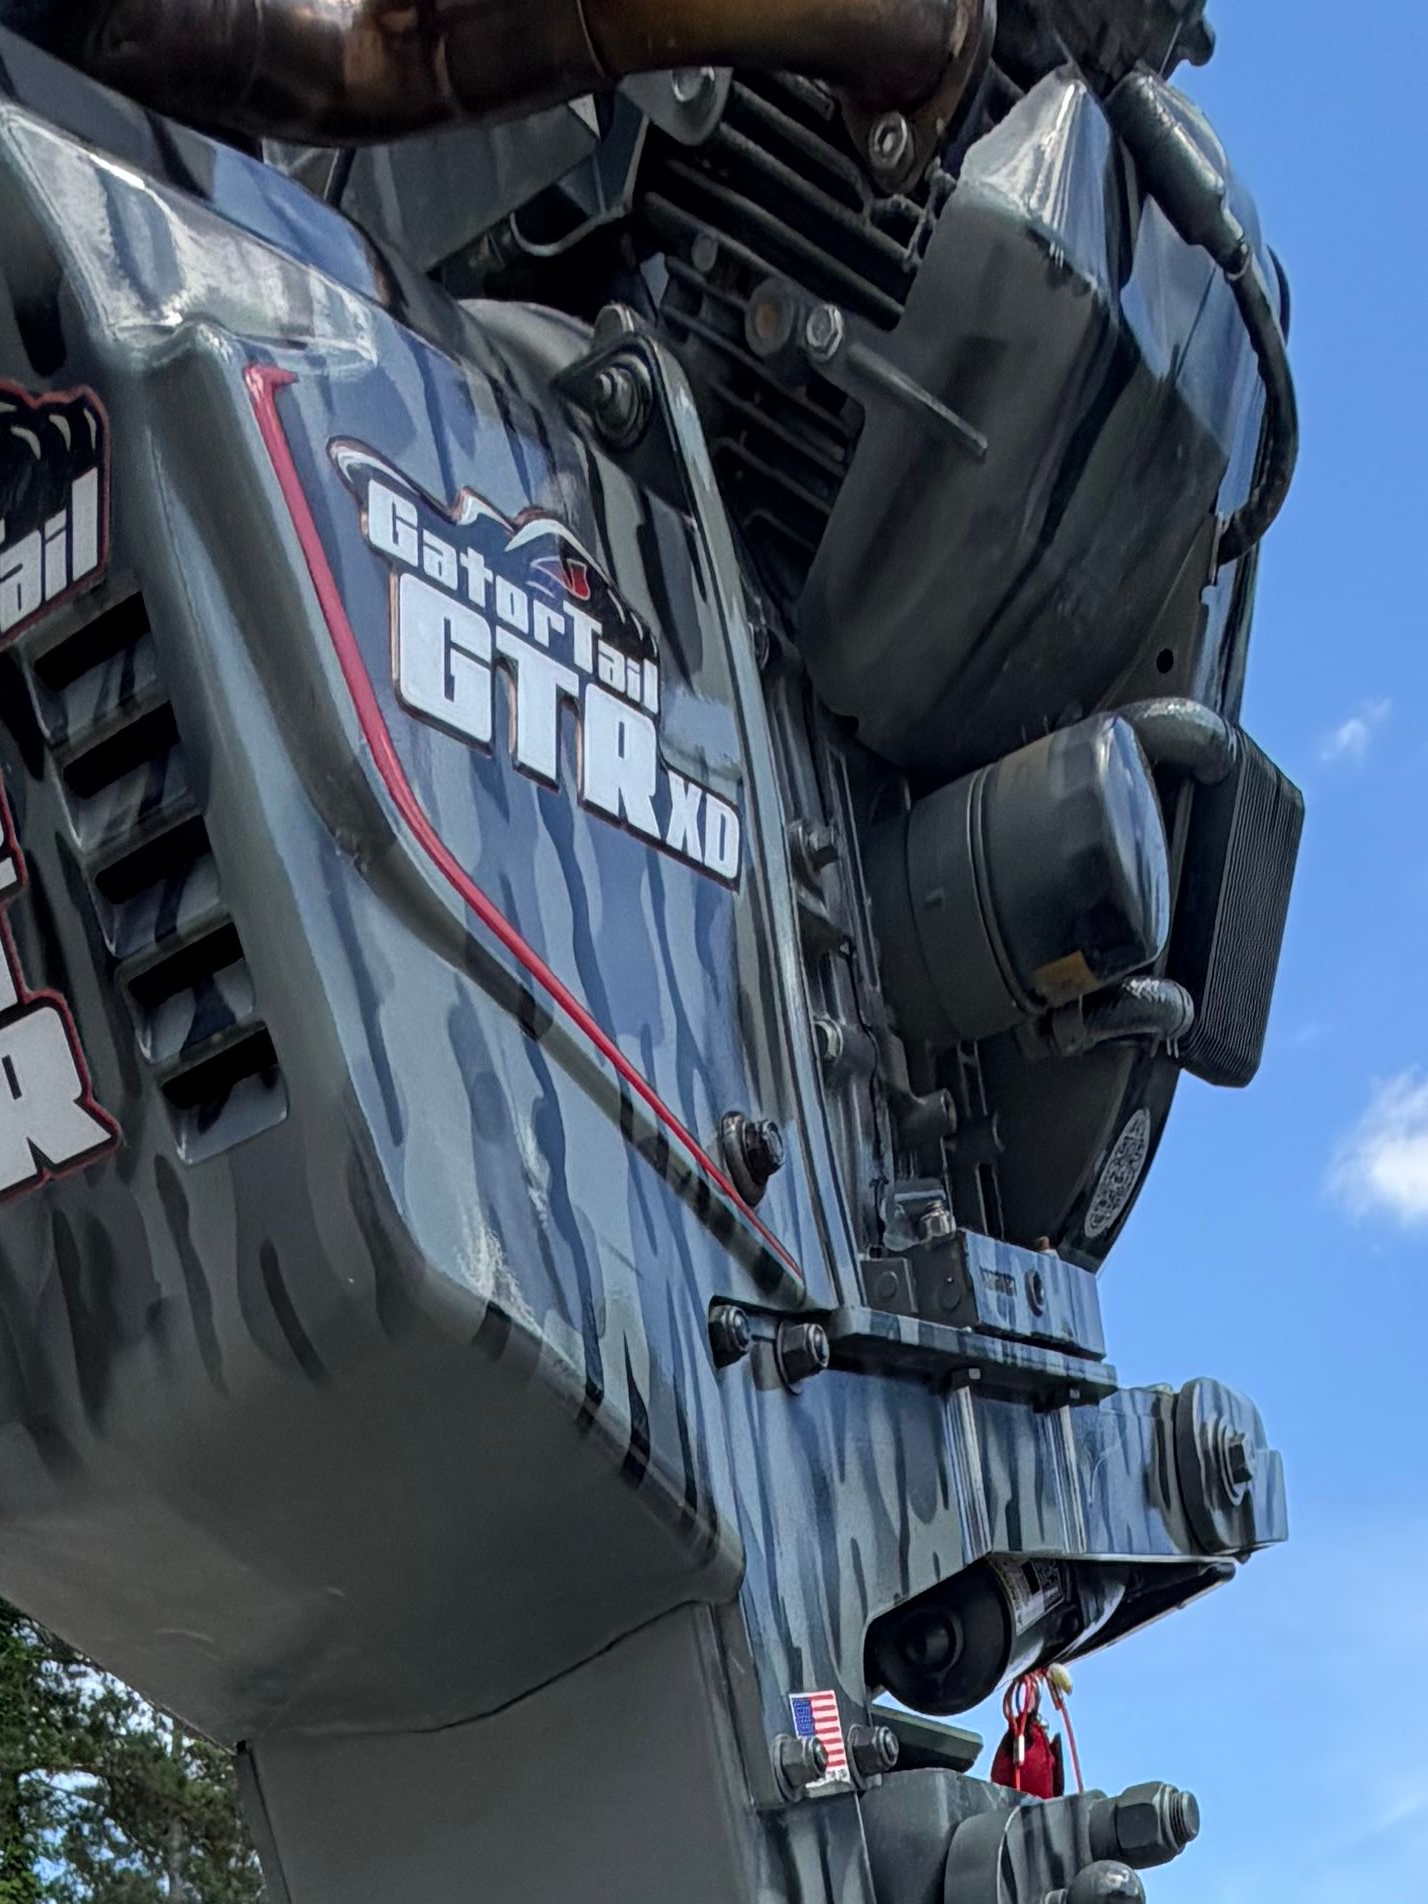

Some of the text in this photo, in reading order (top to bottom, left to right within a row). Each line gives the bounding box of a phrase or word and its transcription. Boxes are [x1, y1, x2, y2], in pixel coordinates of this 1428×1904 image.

[367, 479, 659, 711] GatorTail
[399, 572, 740, 880] GTR XD
